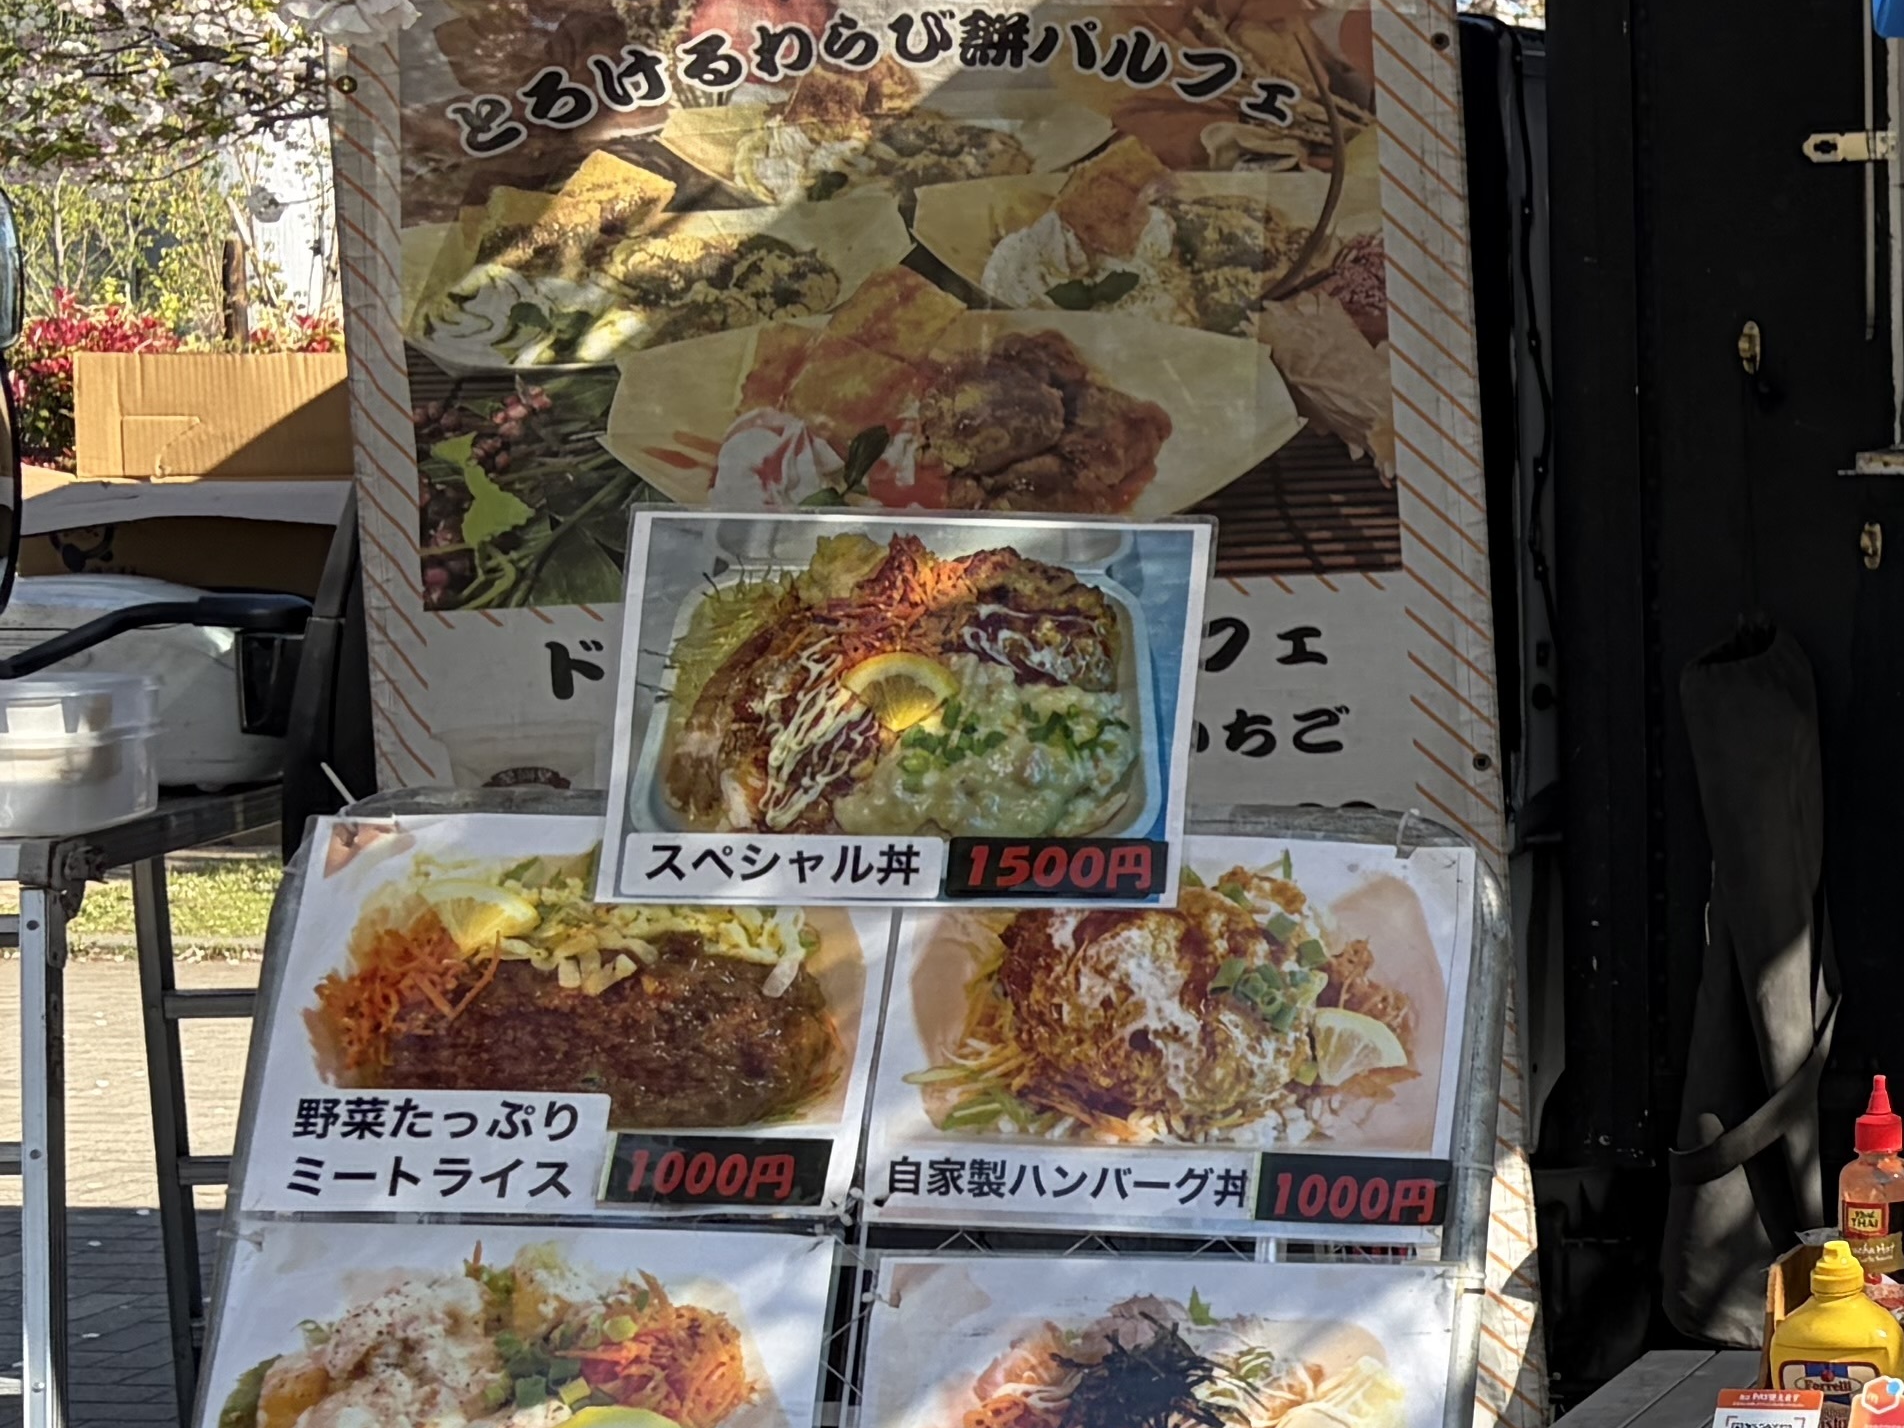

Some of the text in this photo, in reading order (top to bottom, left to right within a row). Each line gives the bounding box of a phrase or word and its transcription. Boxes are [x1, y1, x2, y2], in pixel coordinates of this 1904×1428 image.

[445, 5, 1304, 156] とろけるわらび餅パルフェ
[646, 845, 921, 888] スペシャル丼
[961, 845, 1154, 893] 1500円
[292, 1096, 583, 1145] 野菜たっぷり
[286, 1154, 573, 1200] ミートライス
[626, 1151, 796, 1202] 1000円
[889, 1159, 1250, 1208] 自家製ハンバーグ丼
[1272, 1174, 1438, 1224] 1000円
